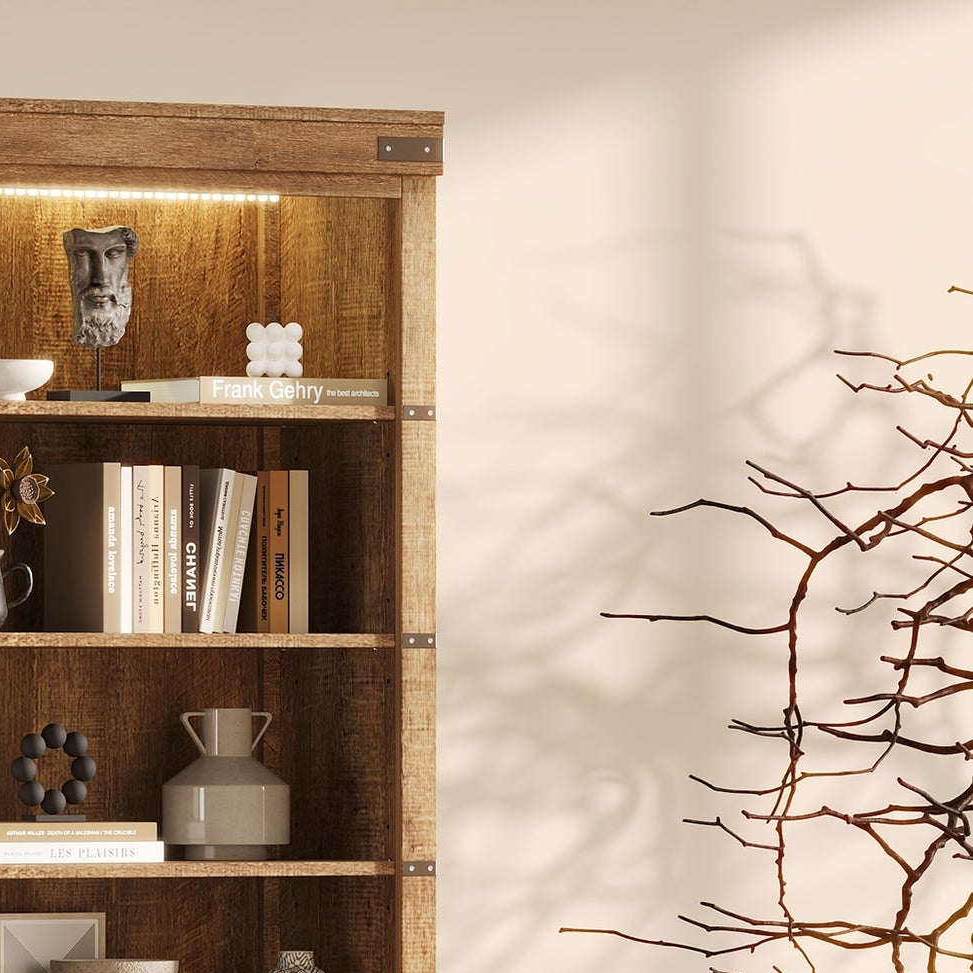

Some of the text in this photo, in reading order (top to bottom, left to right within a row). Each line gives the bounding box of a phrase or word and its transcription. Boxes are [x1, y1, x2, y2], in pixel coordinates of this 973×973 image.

[212, 379, 380, 404] Frank Gehry the best architects
[108, 506, 117, 593] amanda lovelace
[275, 553, 285, 600] ПИКАССО
[50, 848, 136, 858] LES PLAISIRS
